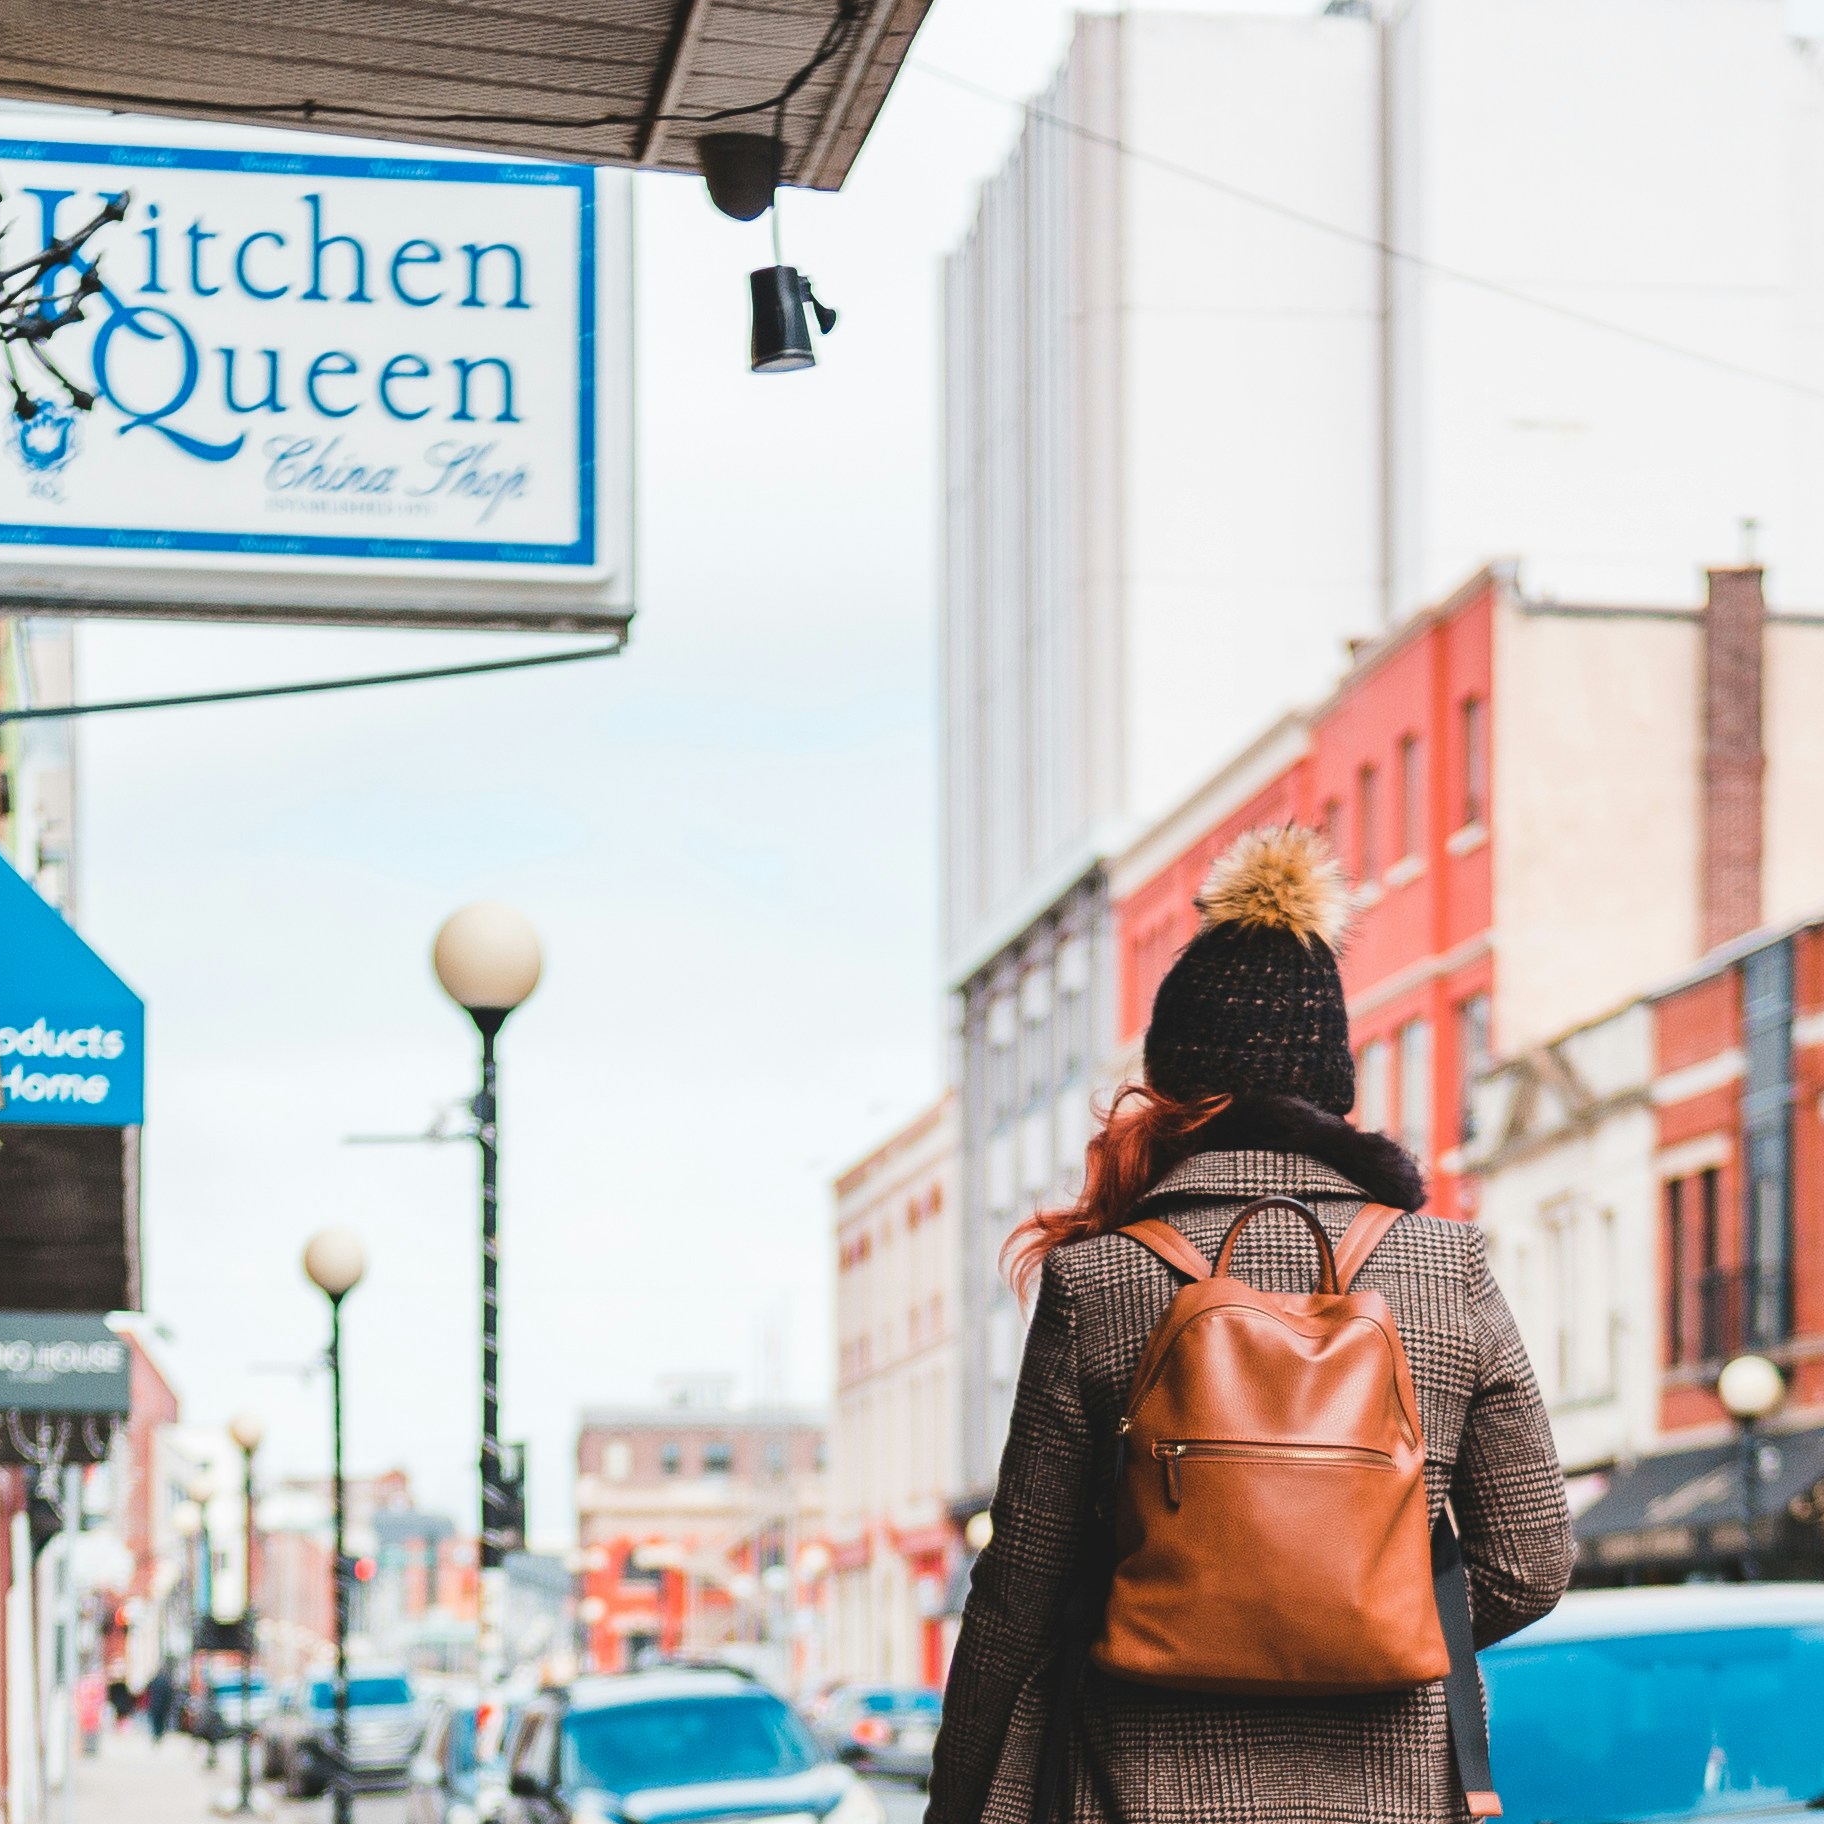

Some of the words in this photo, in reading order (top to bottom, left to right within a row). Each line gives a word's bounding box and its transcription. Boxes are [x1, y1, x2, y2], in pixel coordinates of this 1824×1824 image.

[23, 188, 534, 322] Kitchen
[92, 305, 523, 462] Queen
[261, 432, 402, 493] China
[402, 438, 536, 526] Shop
